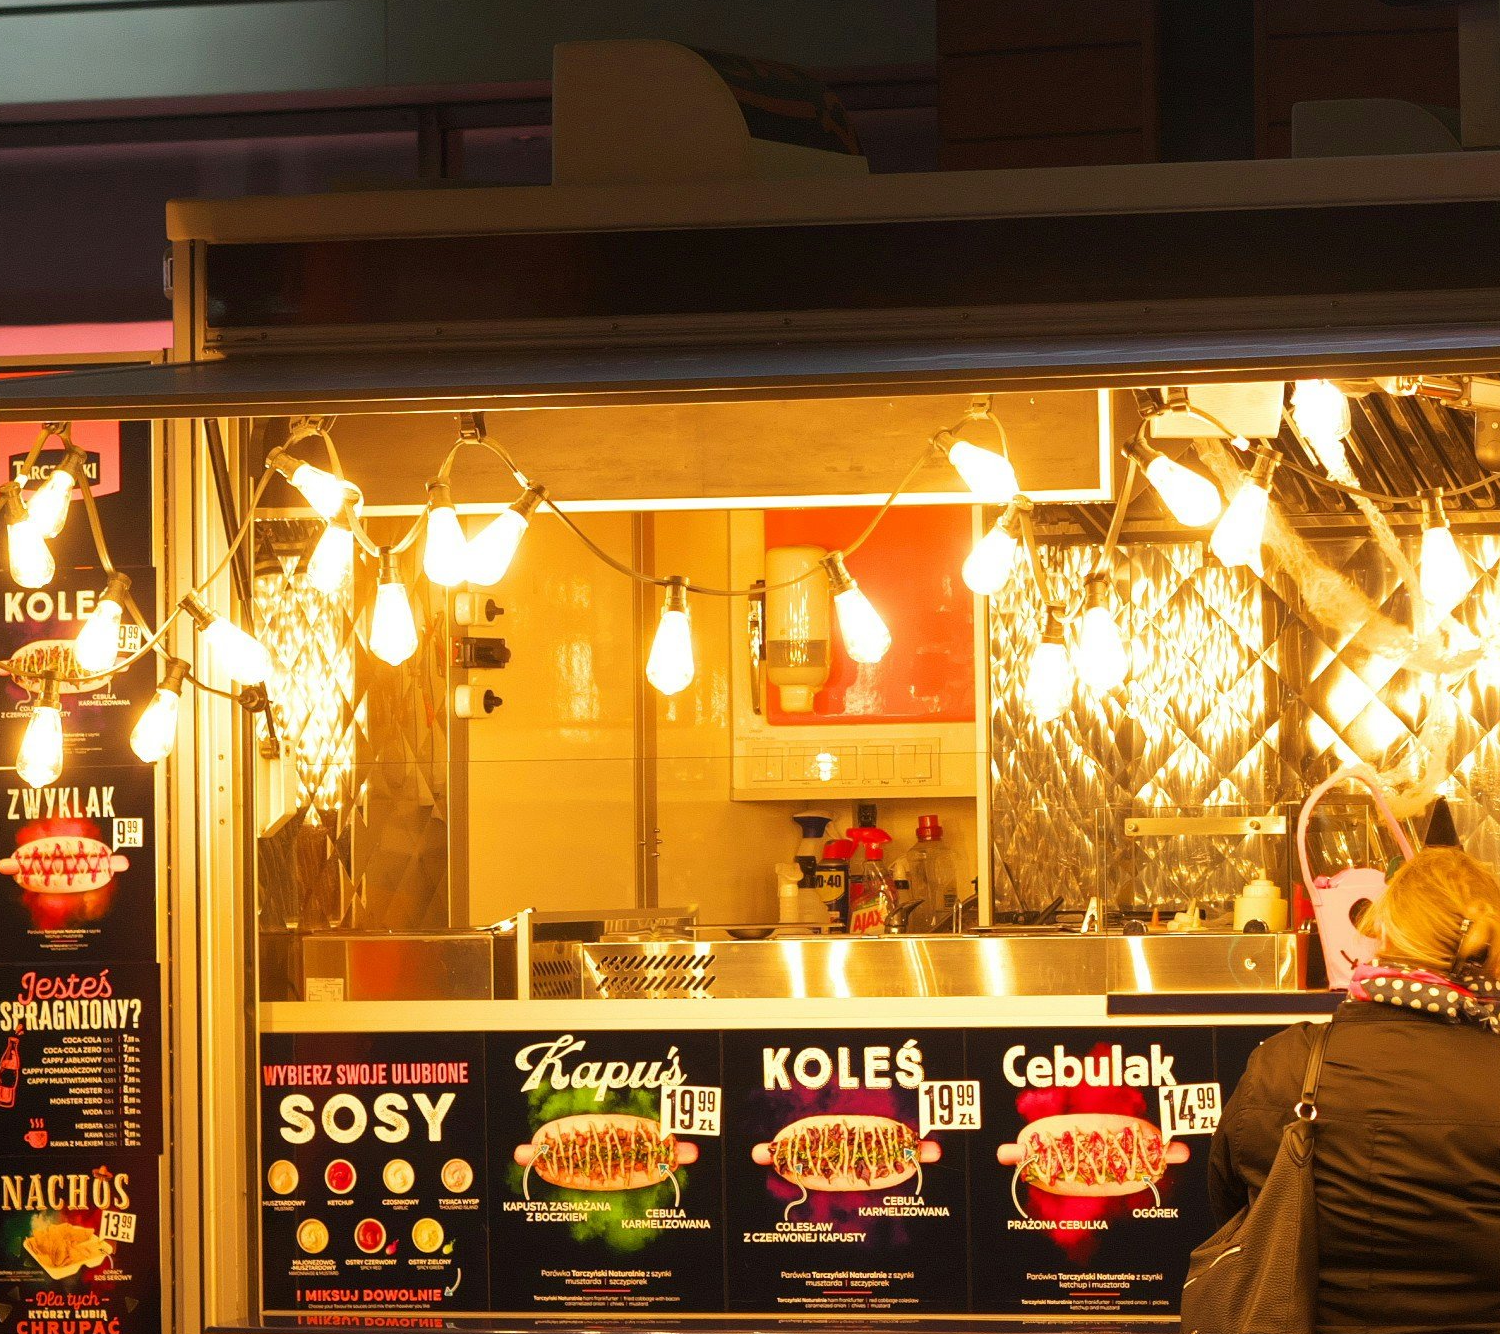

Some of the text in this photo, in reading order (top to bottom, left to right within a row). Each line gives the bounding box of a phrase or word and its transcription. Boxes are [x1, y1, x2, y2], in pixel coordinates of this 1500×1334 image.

[4, 590, 101, 623] KOLE
[7, 786, 115, 820] ZWYKLAK
[117, 820, 138, 844] 9 99
[853, 910, 883, 934] AJAX
[18, 968, 113, 1005] Jesteś
[0, 999, 141, 1032] SPRAGNIONY?
[62, 1036, 101, 1044] COCA-COLA
[43, 1046, 101, 1054] COCA-COLA ZERO
[514, 1034, 687, 1101] Kapuś
[763, 1038, 925, 1090] KOLEŚ
[1003, 1044, 1177, 1087] Cebulak
[264, 1062, 468, 1086] WYBIERZ SWOJE ULUBIONE
[667, 1089, 715, 1130] 19 99
[924, 1084, 974, 1125] 19 99
[1164, 1087, 1215, 1131] 14 99
[279, 1093, 456, 1144] SOSY
[959, 1114, 975, 1125] ZŁ
[699, 1119, 715, 1131] ZŁ
[1, 1173, 130, 1211] NACHOS
[327, 1199, 354, 1207] KETCHUP
[503, 1201, 611, 1211] KAPUSTA ZASMAŻANA
[883, 1196, 924, 1206] CEBULA
[526, 1213, 588, 1221] Z BOCZKIEM
[645, 1209, 686, 1218] CEBULA
[859, 1207, 949, 1217] KARMELIZOWANA
[1132, 1207, 1178, 1218] OGÓREK
[104, 1213, 132, 1238] 13 99
[621, 1220, 710, 1229] KARMELIZOWANA
[776, 1222, 833, 1232] COLESŁAW
[1007, 1219, 1108, 1230] PRAŻONA CEBULKA
[744, 1233, 866, 1242] Z CZERWONEJ KAPUSTY
[781, 1271, 811, 1280] Parówka
[812, 1271, 848, 1280] Tarczyński
[850, 1271, 887, 1280] Naturalnie
[1027, 1273, 1057, 1281] Parówka
[1058, 1273, 1095, 1281] Tarczyński
[1097, 1273, 1135, 1281] Naturalnie
[850, 1280, 890, 1288] szczypiorek
[1059, 1281, 1130, 1289] ketchup musztarda
[36, 1291, 100, 1310] Dla tych
[296, 1289, 442, 1302] I MIKSUJ DOWOLNIE
[28, 1307, 108, 1321] KTÓRZY LUBIĄ
